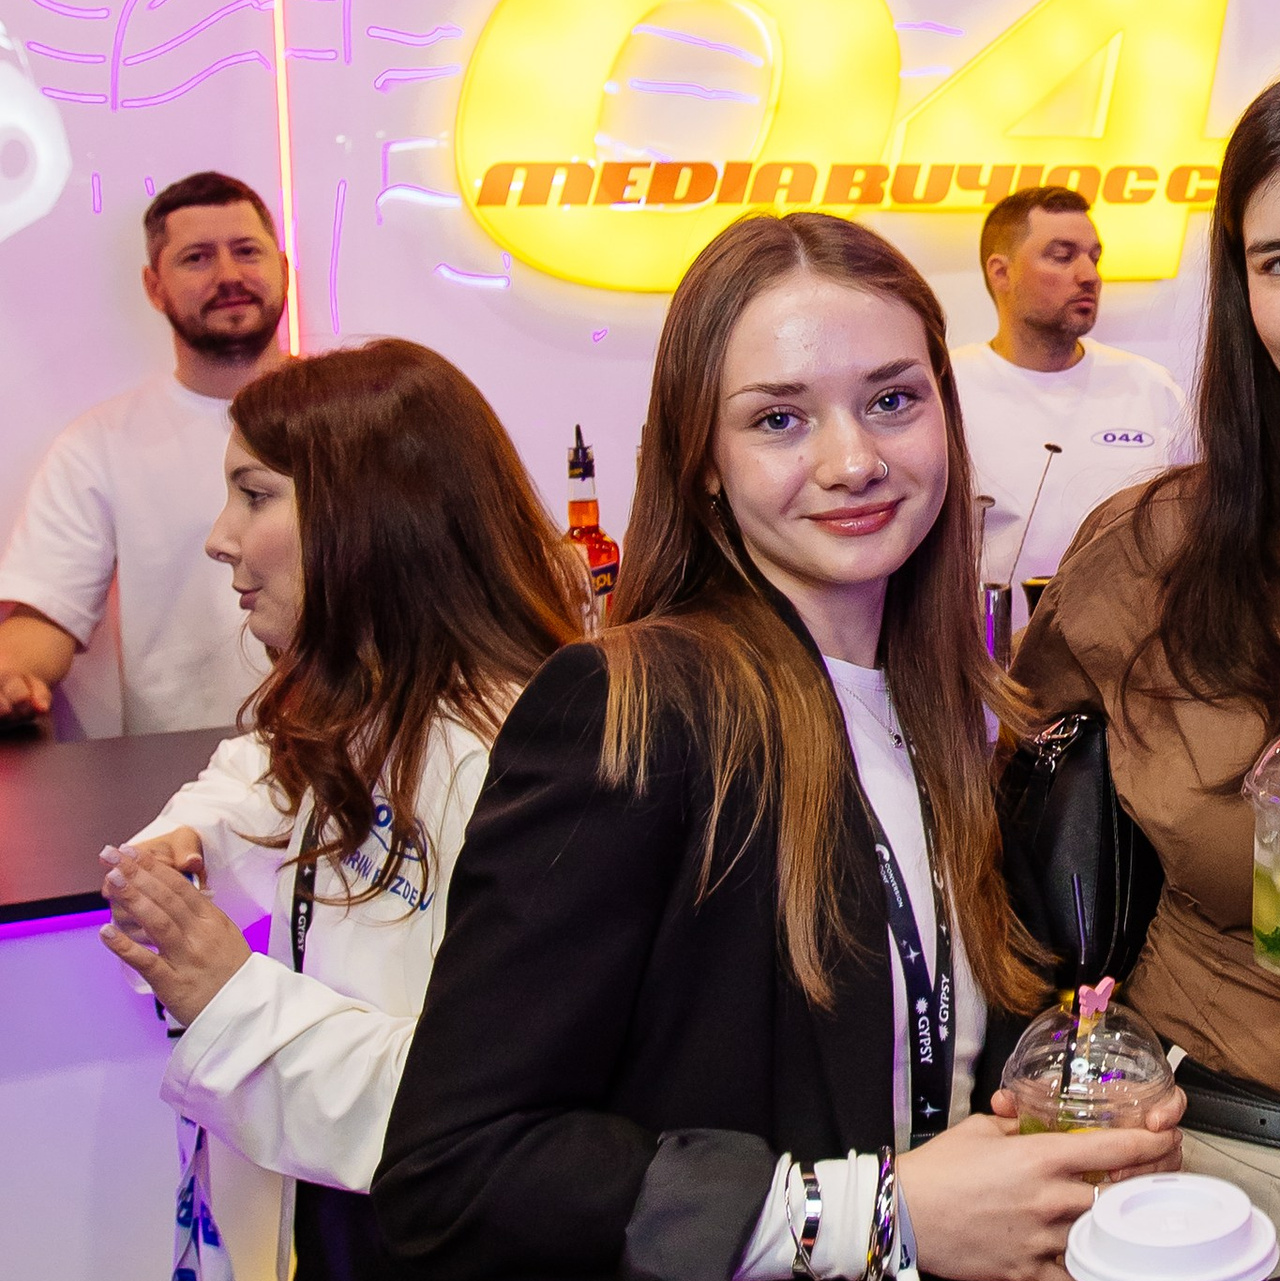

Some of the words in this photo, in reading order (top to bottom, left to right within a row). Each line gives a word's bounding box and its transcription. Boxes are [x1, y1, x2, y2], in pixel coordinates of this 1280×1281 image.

[1103, 433, 1144, 444] 044
[884, 862, 904, 909] CONVERSION
[297, 914, 307, 953] GYPSY
[938, 973, 951, 1024] GYPSY
[917, 1015, 933, 1064] GYPSY
